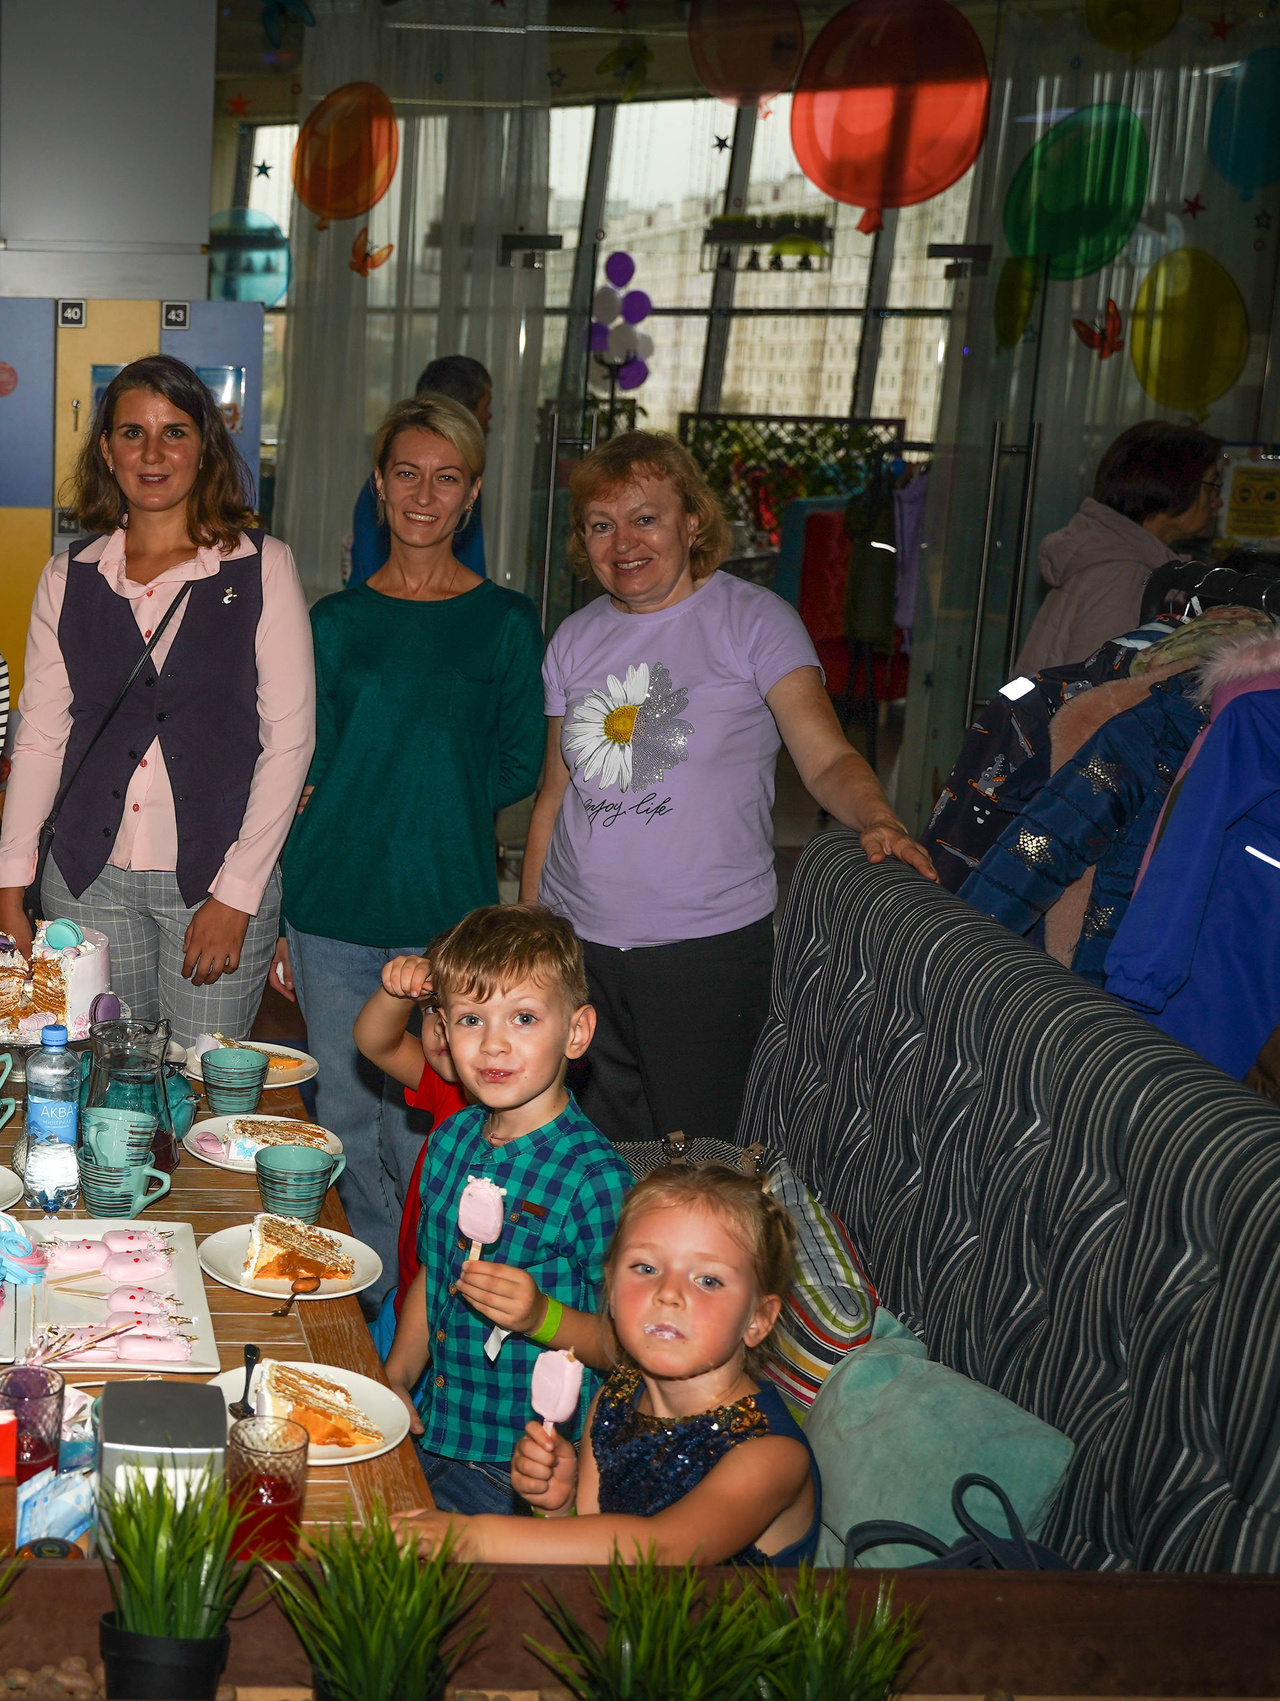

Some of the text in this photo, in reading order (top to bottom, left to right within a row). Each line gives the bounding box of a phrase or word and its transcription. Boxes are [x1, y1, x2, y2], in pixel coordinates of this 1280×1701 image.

[63, 307, 81, 320] 40
[167, 309, 185, 322] 43
[628, 792, 673, 825] life
[40, 1104, 74, 1120] АКВА
